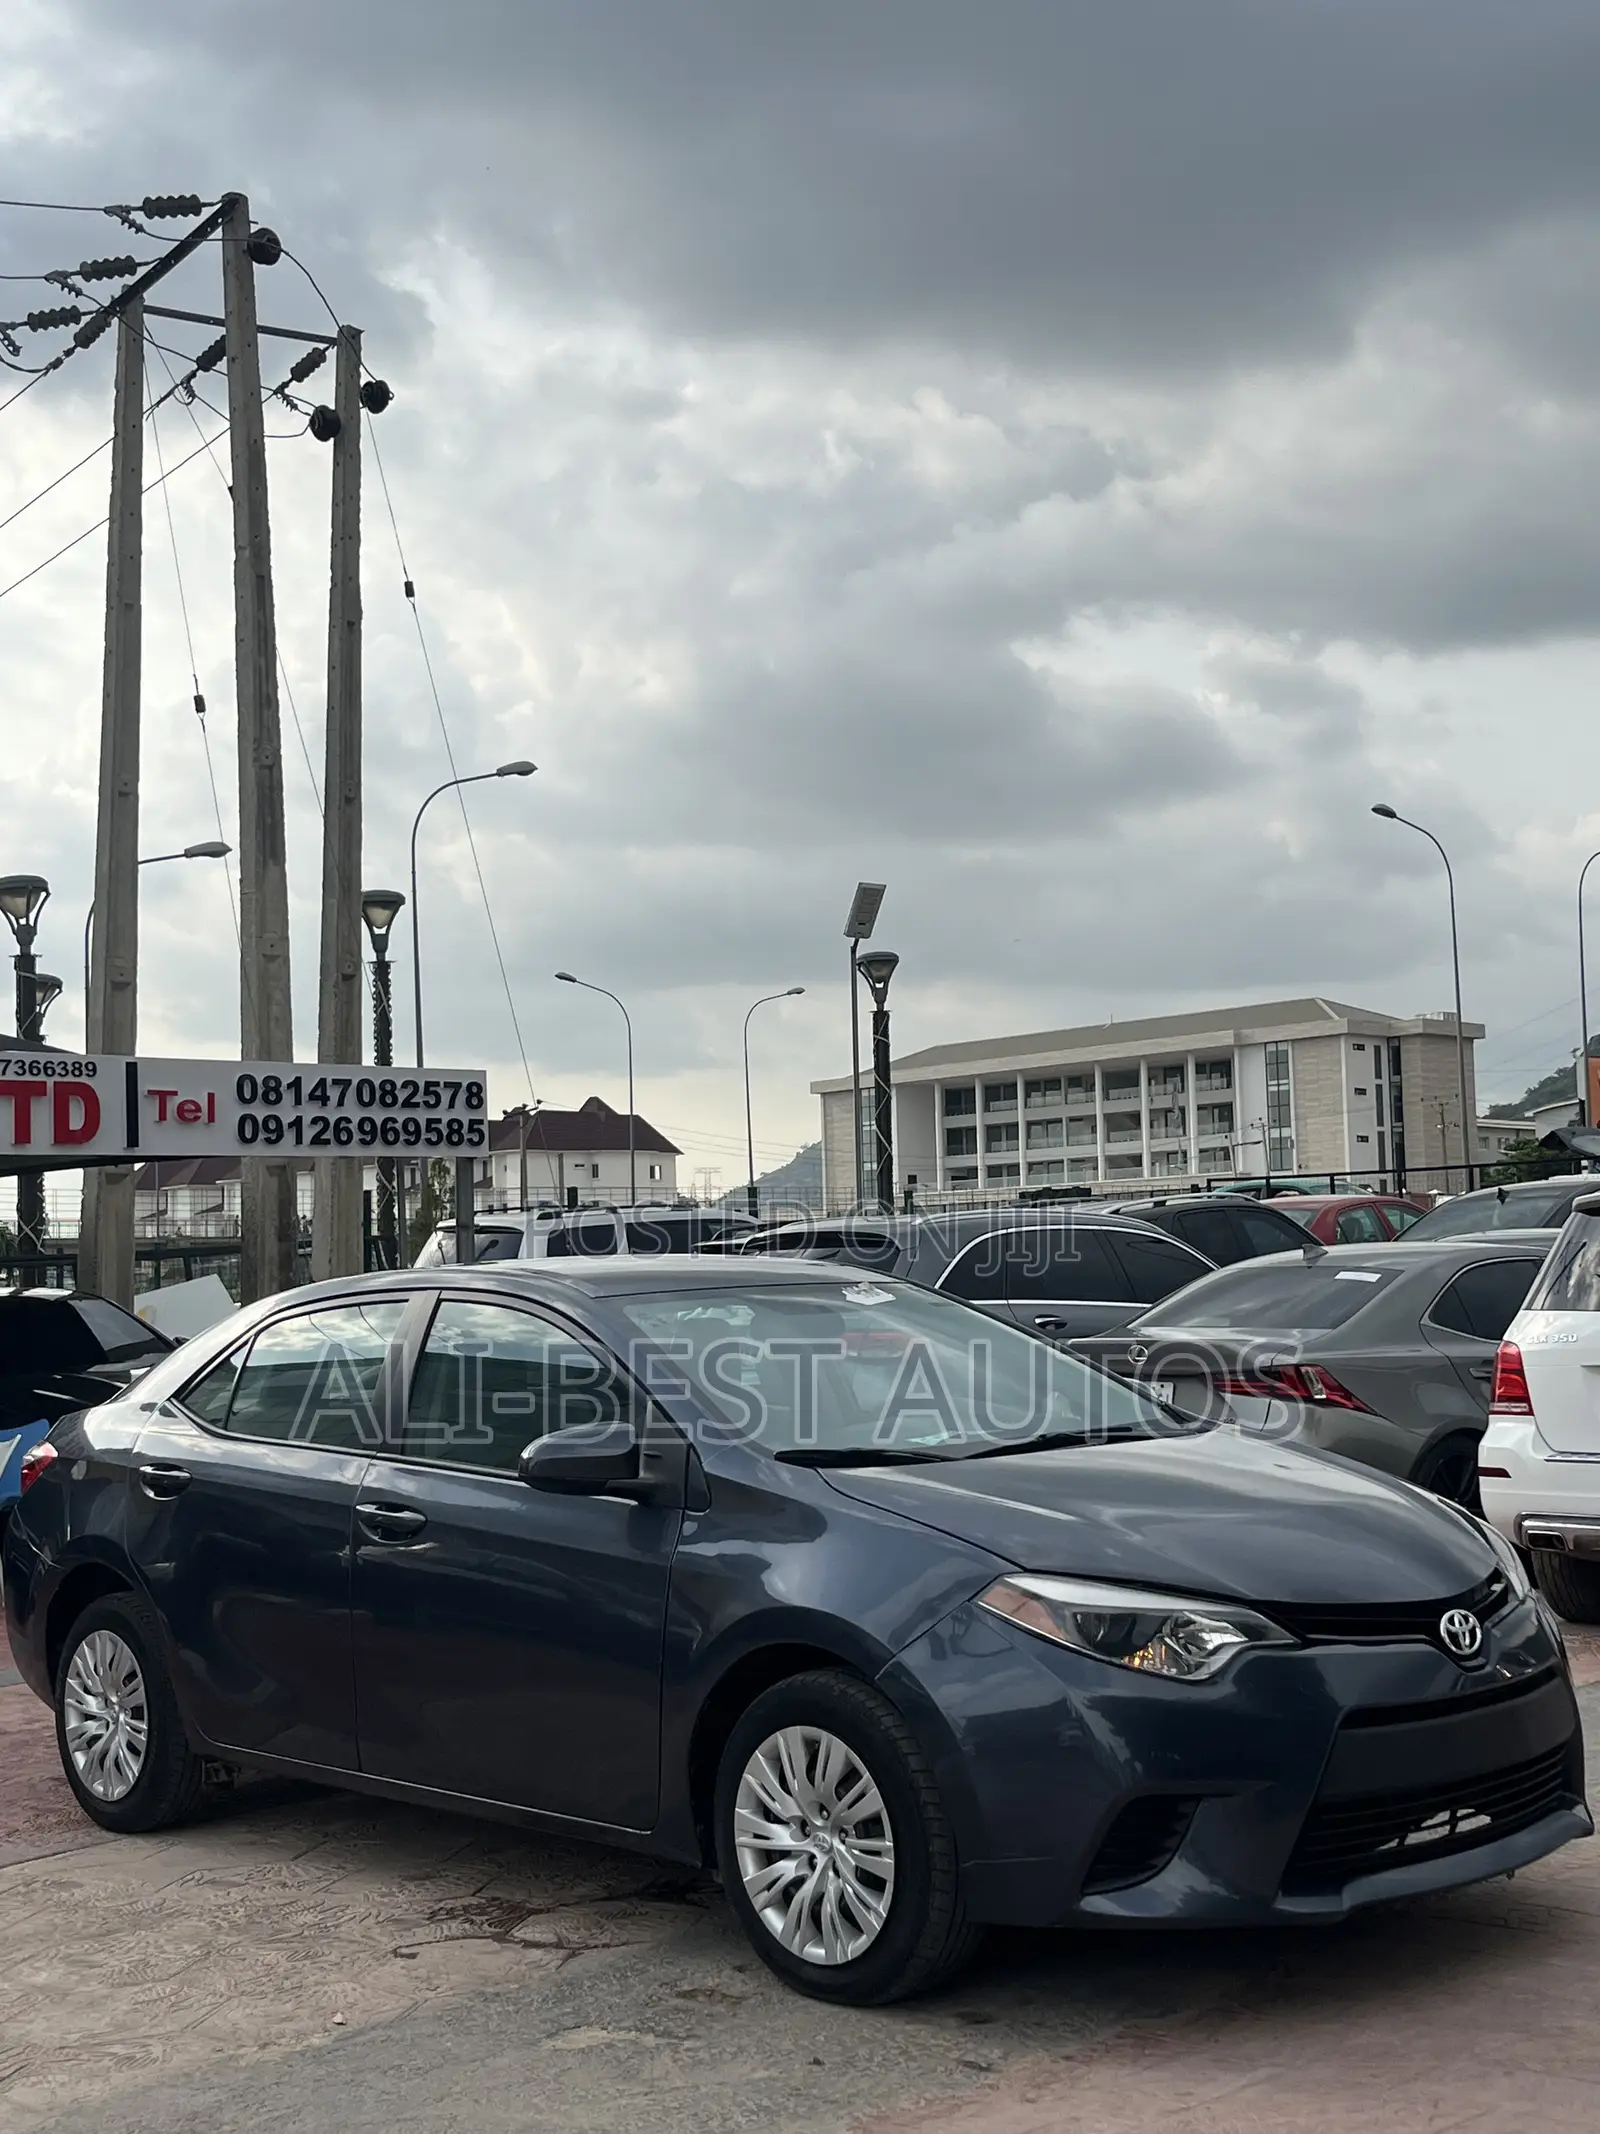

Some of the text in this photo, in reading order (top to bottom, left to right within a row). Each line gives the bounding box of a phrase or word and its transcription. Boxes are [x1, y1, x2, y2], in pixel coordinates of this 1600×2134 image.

[0, 1059, 98, 1078] 7366389
[146, 1089, 215, 1123] Tel
[236, 1073, 485, 1109] 08147082578
[237, 1113, 486, 1147] 09126969585
[1552, 1333, 1577, 1343] 350
